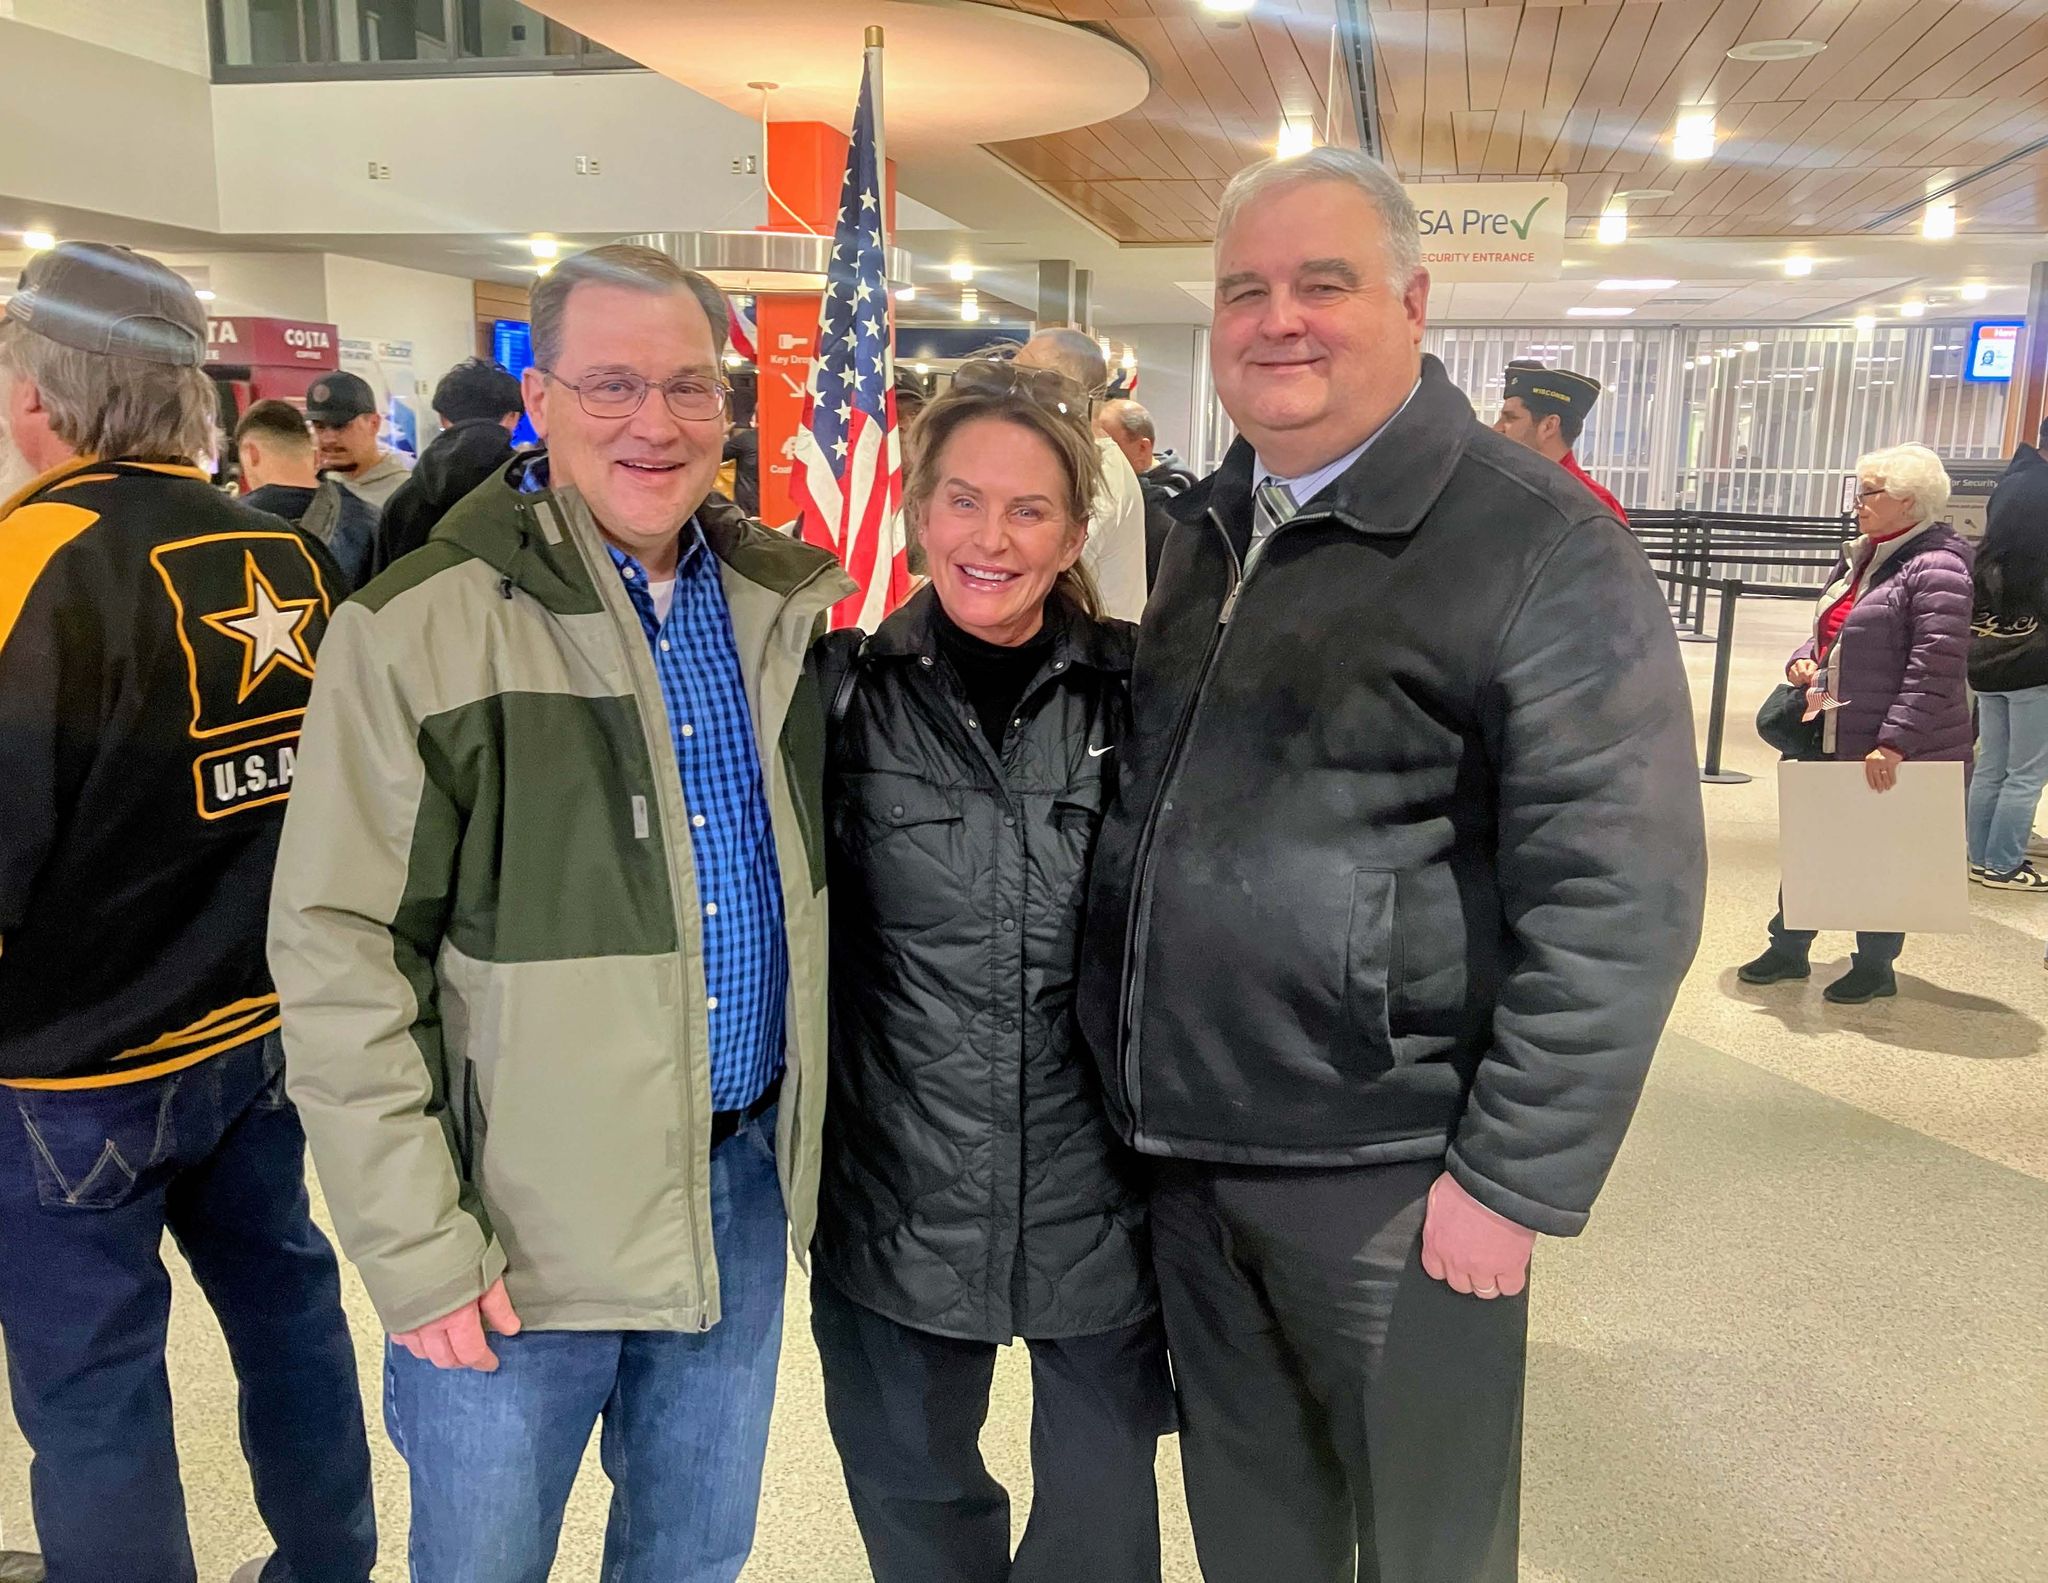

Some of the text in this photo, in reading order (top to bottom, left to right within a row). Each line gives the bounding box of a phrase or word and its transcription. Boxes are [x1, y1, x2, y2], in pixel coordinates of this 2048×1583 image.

[1416, 209, 1508, 235] SA Pre
[1421, 252, 1535, 262] ECURITY ENTRANCE
[284, 328, 330, 349] COSTA
[770, 355, 788, 366] Key
[1962, 479, 1999, 489] Security
